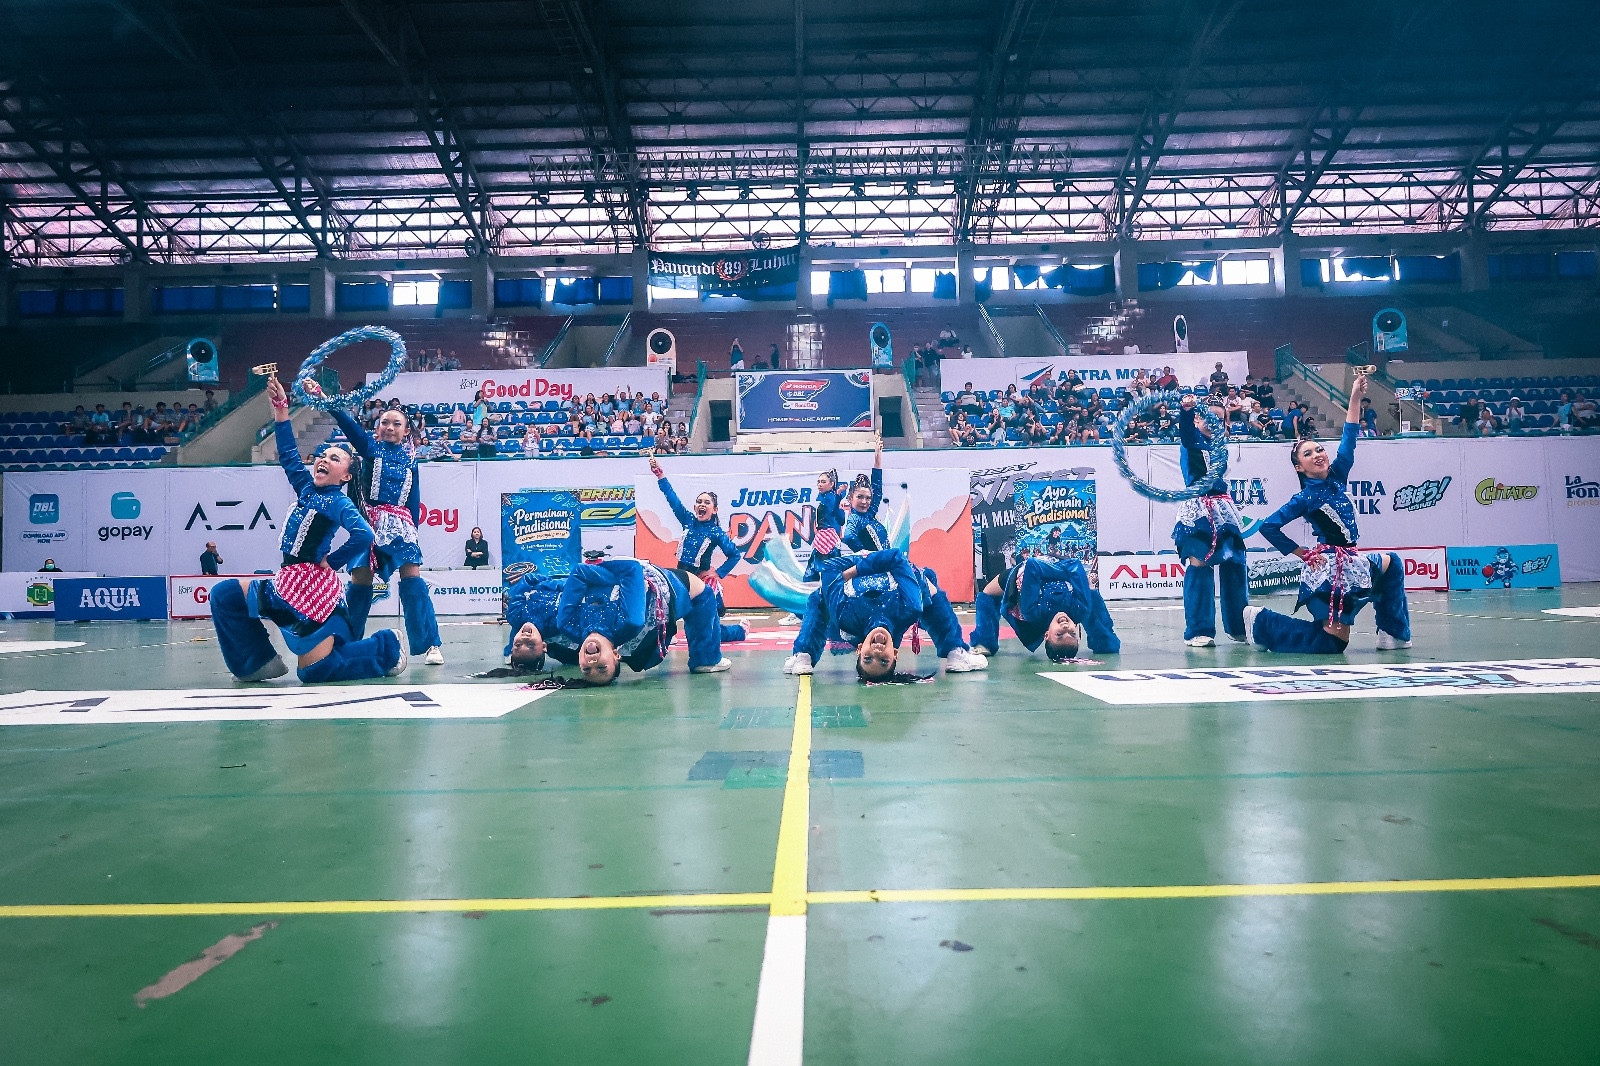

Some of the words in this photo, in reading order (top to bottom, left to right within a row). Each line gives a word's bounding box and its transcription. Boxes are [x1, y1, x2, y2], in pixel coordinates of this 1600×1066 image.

[724, 260, 742, 274] 89
[1058, 369, 1111, 381] ATRA
[482, 379, 531, 398] Good
[535, 379, 572, 400] Day
[1349, 480, 1386, 496] TRA
[1565, 475, 1582, 485] La
[731, 487, 812, 507] JUNIOR
[1041, 485, 1067, 499] Ayo
[1229, 477, 1268, 511] UA
[1566, 486, 1600, 498] Fon
[33, 502, 55, 511] DBL
[1033, 496, 1082, 514] Bermain
[514, 509, 568, 525] Permainan
[1024, 507, 1090, 528] Tradisional
[98, 526, 153, 541] gopay
[513, 518, 571, 536] tradisional
[729, 505, 815, 565] DAN
[1404, 558, 1439, 580] Day
[1451, 559, 1480, 567] ULTRA
[434, 587, 467, 595] ASTRA
[1122, 581, 1143, 589] Astra
[1146, 580, 1173, 588] Honda
[80, 588, 140, 611] AQUA
